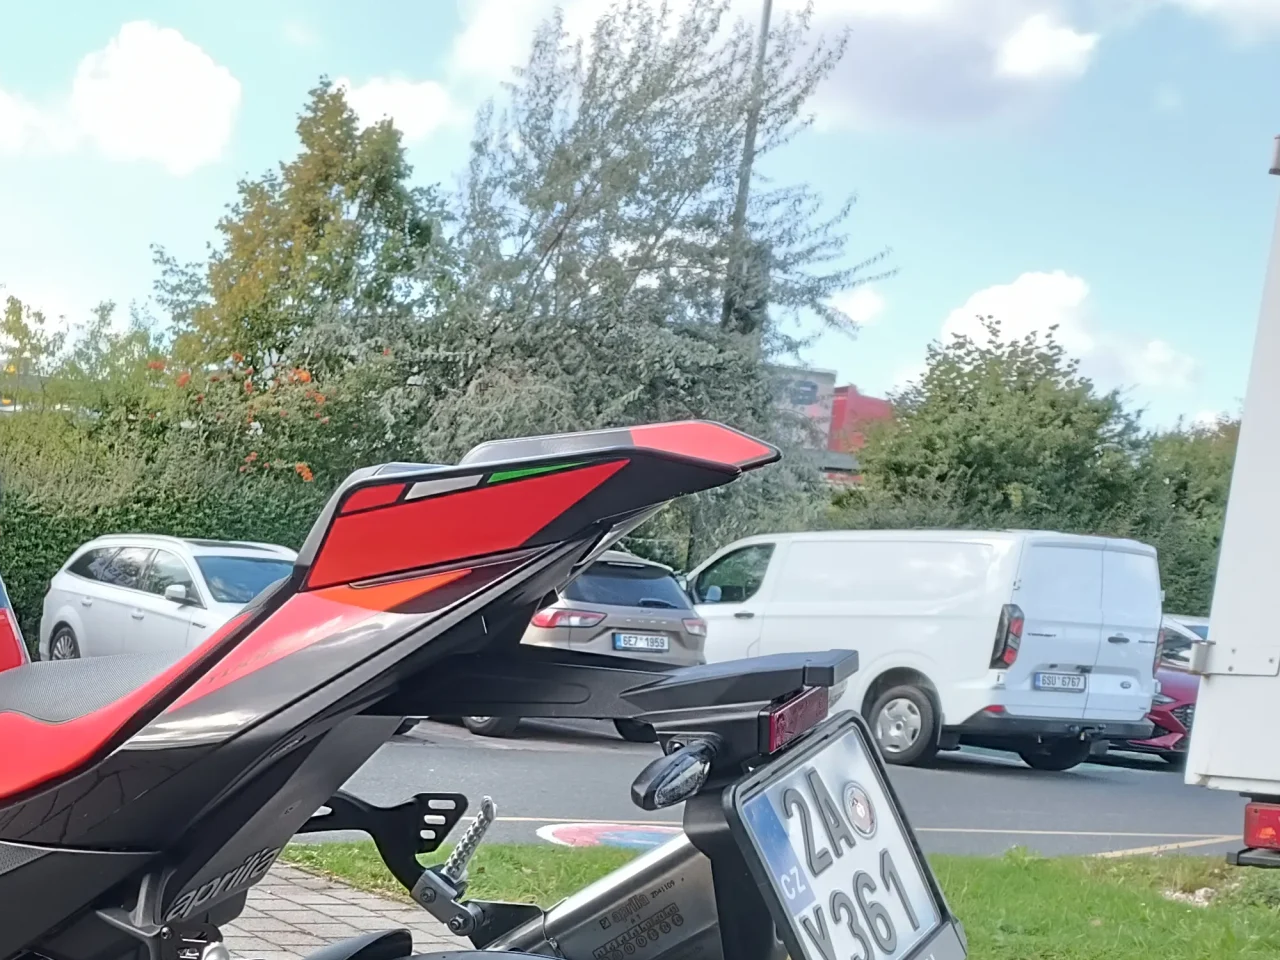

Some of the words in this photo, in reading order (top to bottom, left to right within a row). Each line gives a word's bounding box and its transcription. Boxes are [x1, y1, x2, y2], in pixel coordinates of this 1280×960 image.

[622, 636, 638, 646] 6E7
[646, 638, 665, 648] 1959
[1041, 675, 1057, 686] 6SU
[1061, 676, 1081, 687] 6767
[782, 766, 856, 878] 2A
[166, 847, 281, 922] aprilia
[781, 868, 806, 900] CZ
[611, 893, 651, 925] aprilia
